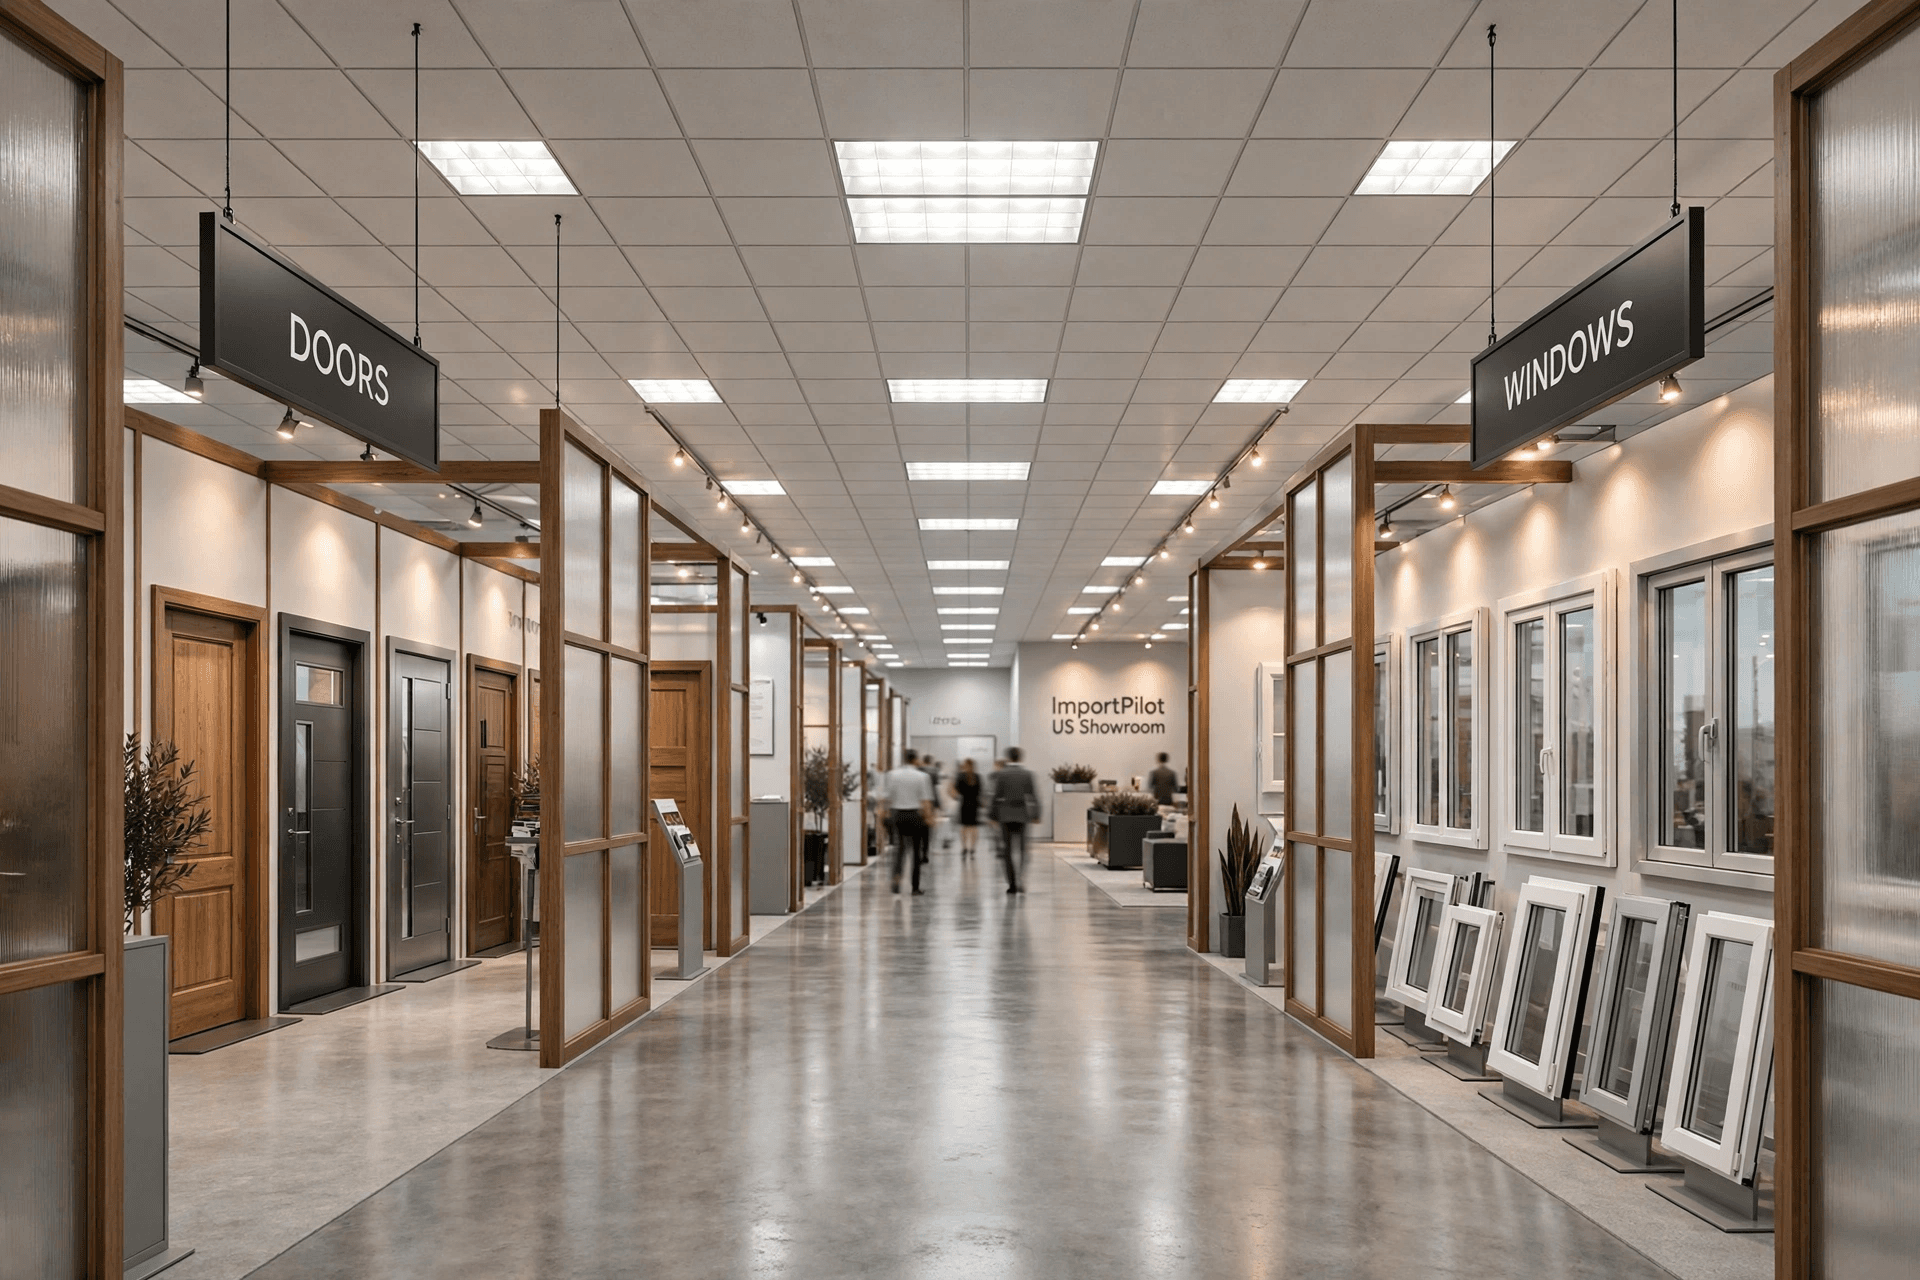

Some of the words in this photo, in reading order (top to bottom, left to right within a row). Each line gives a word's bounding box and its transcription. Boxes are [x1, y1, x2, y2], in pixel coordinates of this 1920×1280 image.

[290, 312, 389, 406] DOORS
[1503, 300, 1634, 411] WINDOWS
[1052, 696, 1165, 719] ImportPilot
[1052, 719, 1074, 735] US
[1079, 719, 1165, 735] Showroom
